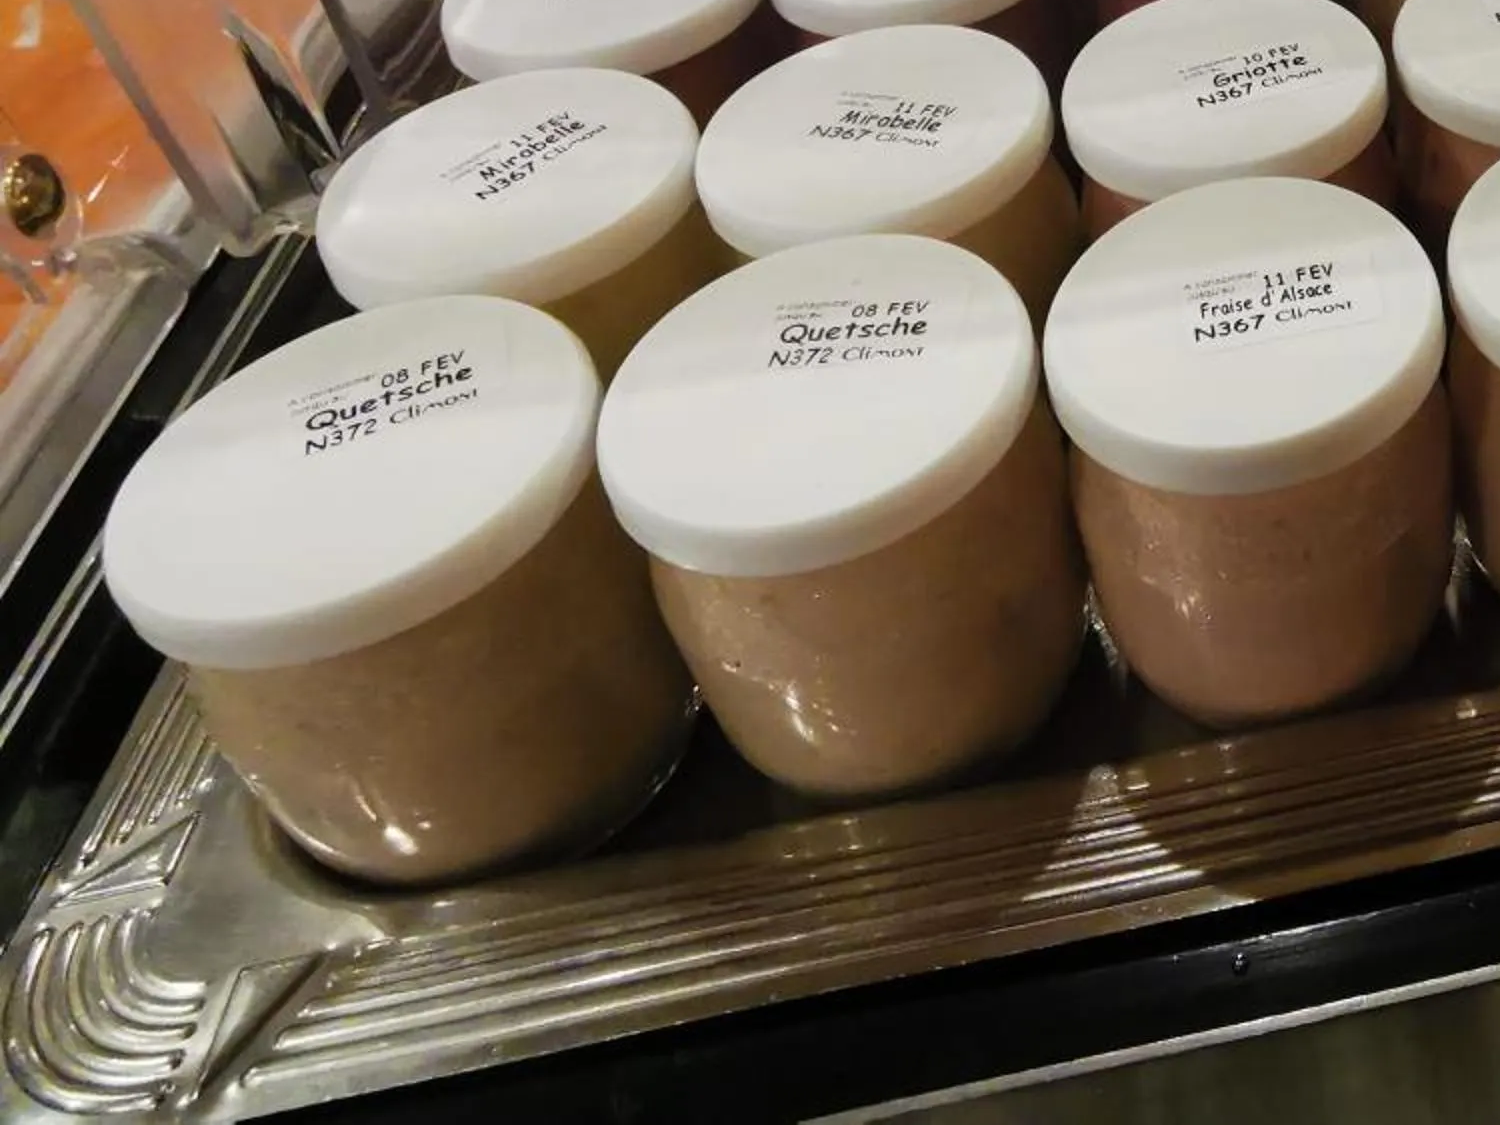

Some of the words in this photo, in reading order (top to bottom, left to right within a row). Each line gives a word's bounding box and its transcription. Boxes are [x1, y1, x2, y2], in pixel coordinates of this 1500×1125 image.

[1267, 41, 1300, 59] FEV
[1213, 55, 1308, 88] Griotte
[1196, 81, 1254, 109] N367
[536, 109, 571, 134] FEV
[839, 108, 943, 133] Mirabelle
[919, 103, 958, 118] FEV
[807, 124, 873, 143] N367
[478, 119, 586, 181] Mirabelle
[474, 160, 536, 201] N367
[1262, 271, 1286, 290] 11
[1295, 262, 1333, 283] FEV
[851, 303, 879, 319] 08
[887, 299, 931, 317] FEV
[1200, 297, 1254, 321] Fraise
[779, 315, 929, 346] Quetsche
[1193, 312, 1266, 343] N367
[381, 367, 410, 389] 08
[419, 348, 466, 376] FEV
[767, 345, 835, 368] N372
[305, 366, 473, 431] Quetsche
[304, 417, 378, 456] N372
